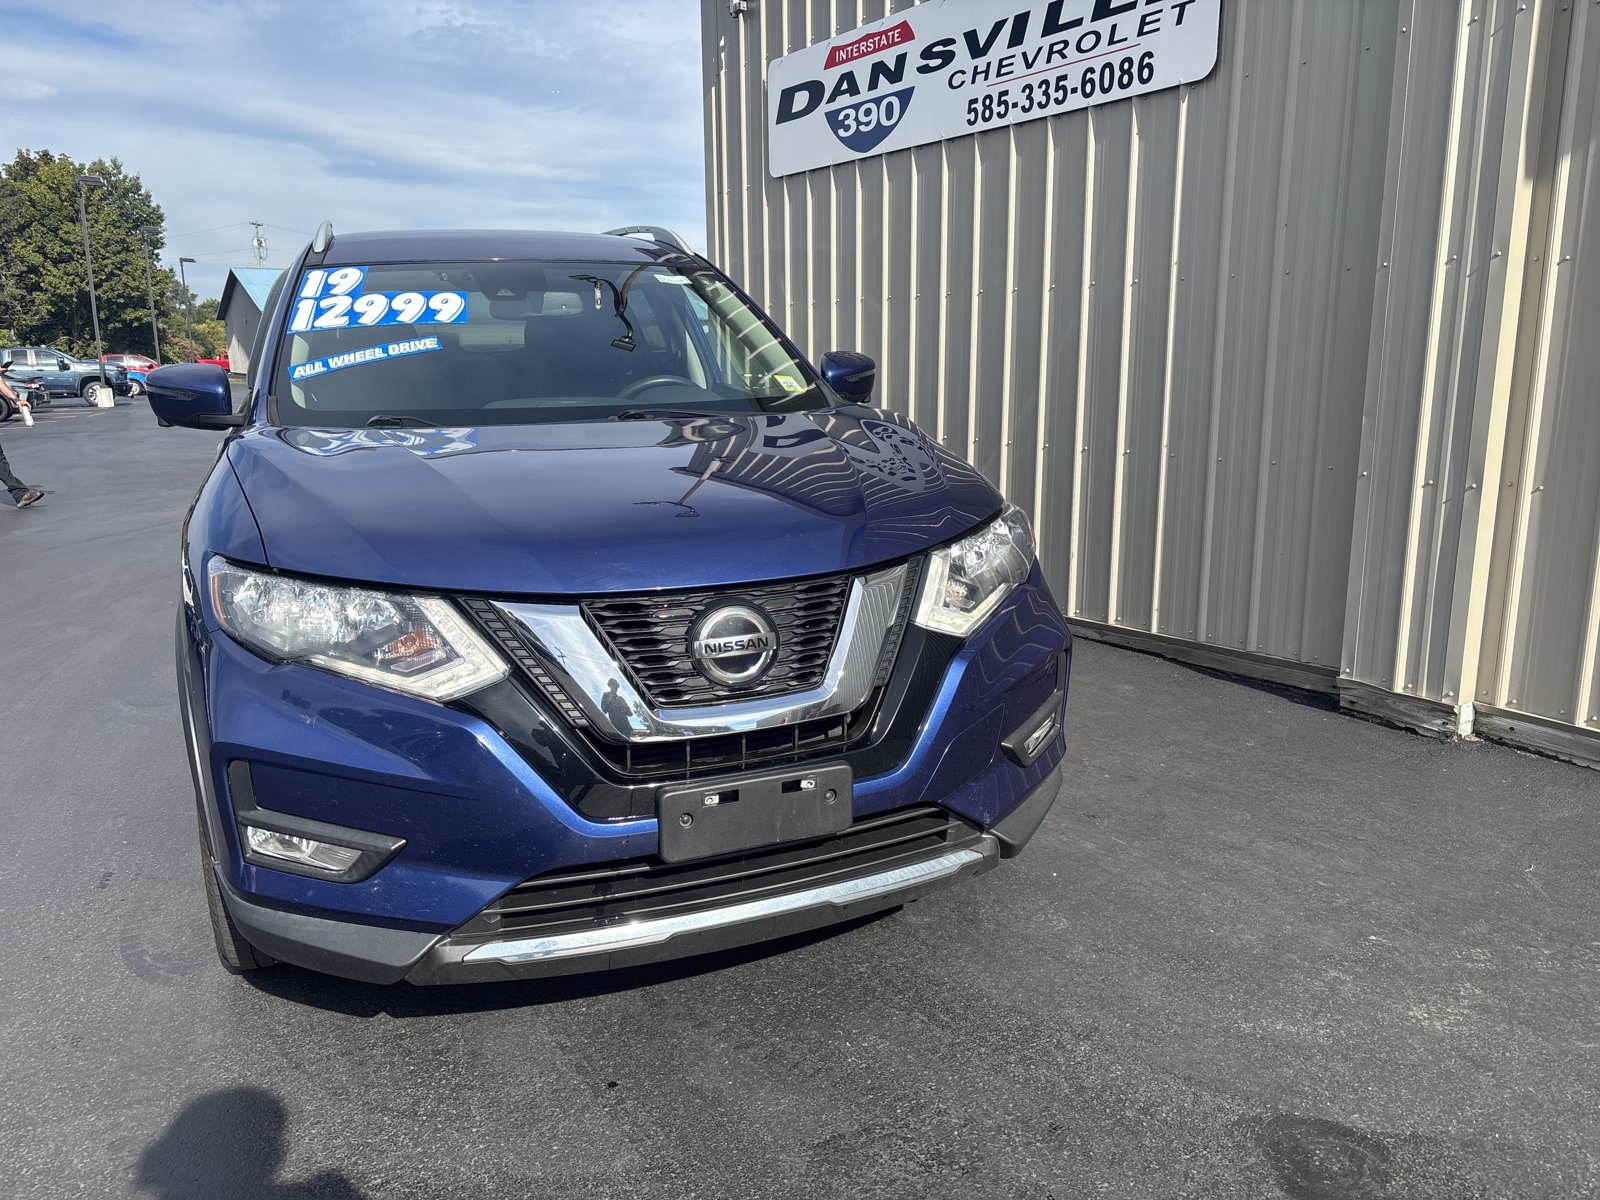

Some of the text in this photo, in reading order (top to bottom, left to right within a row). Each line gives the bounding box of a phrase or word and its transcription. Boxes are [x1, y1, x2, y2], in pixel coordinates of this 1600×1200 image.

[776, 0, 1163, 125] DANSVILL
[835, 28, 902, 63] INTERSTATE
[948, 0, 1196, 90] CHEVROLET
[966, 51, 1155, 126] 585-335-6086
[837, 95, 900, 138] 390
[300, 267, 364, 298] 19
[290, 291, 465, 332] 12999
[293, 337, 438, 379] ALL WHEEL DRIVE
[704, 636, 769, 655] NISSAN
